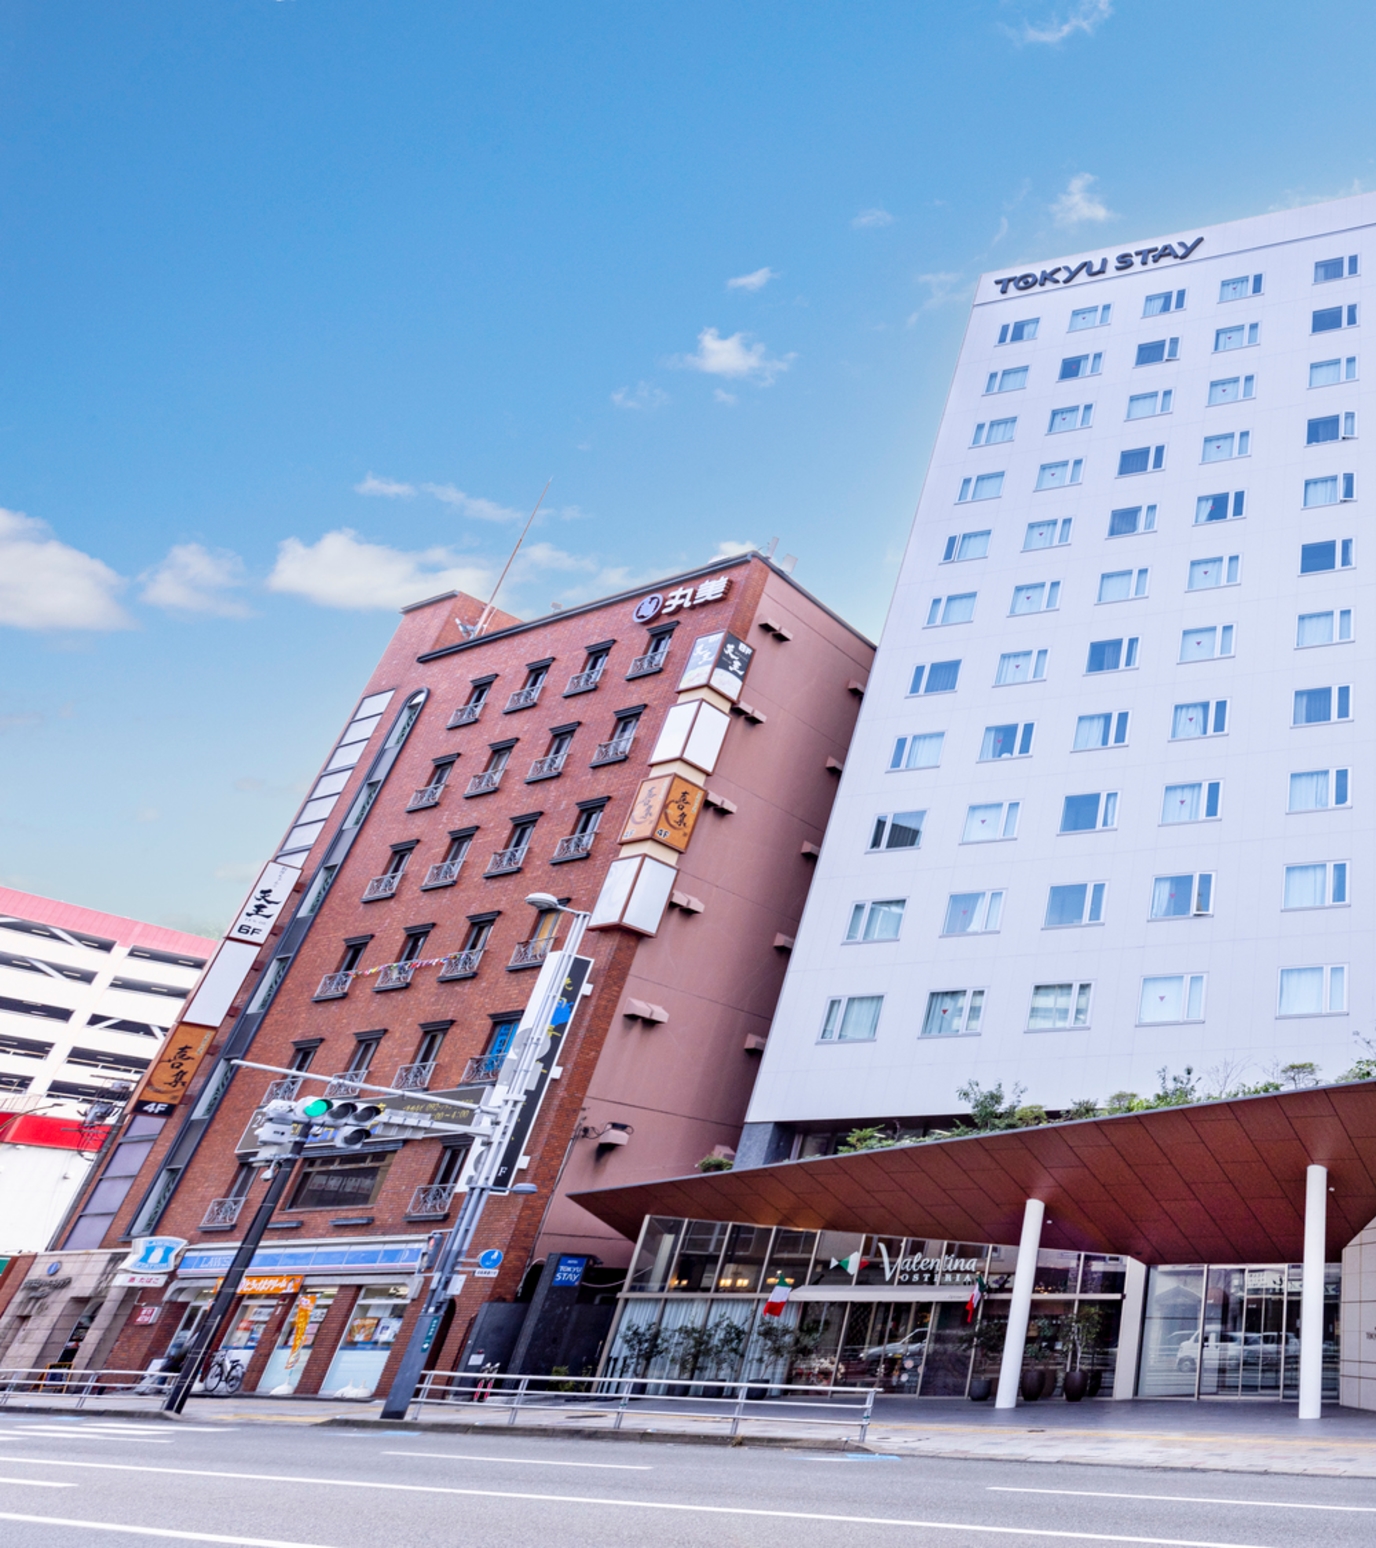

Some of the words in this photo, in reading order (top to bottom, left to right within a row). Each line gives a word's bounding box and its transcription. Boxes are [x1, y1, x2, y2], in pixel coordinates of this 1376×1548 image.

[994, 257, 1107, 294] TOKYU
[1115, 236, 1204, 271] STAY
[237, 924, 262, 936] 6F
[143, 1102, 169, 1113] 4F
[877, 1242, 978, 1282] Valentina
[559, 1265, 583, 1273] TOKYU
[555, 1272, 580, 1281] STAY
[900, 1273, 972, 1282] OSTERIA
